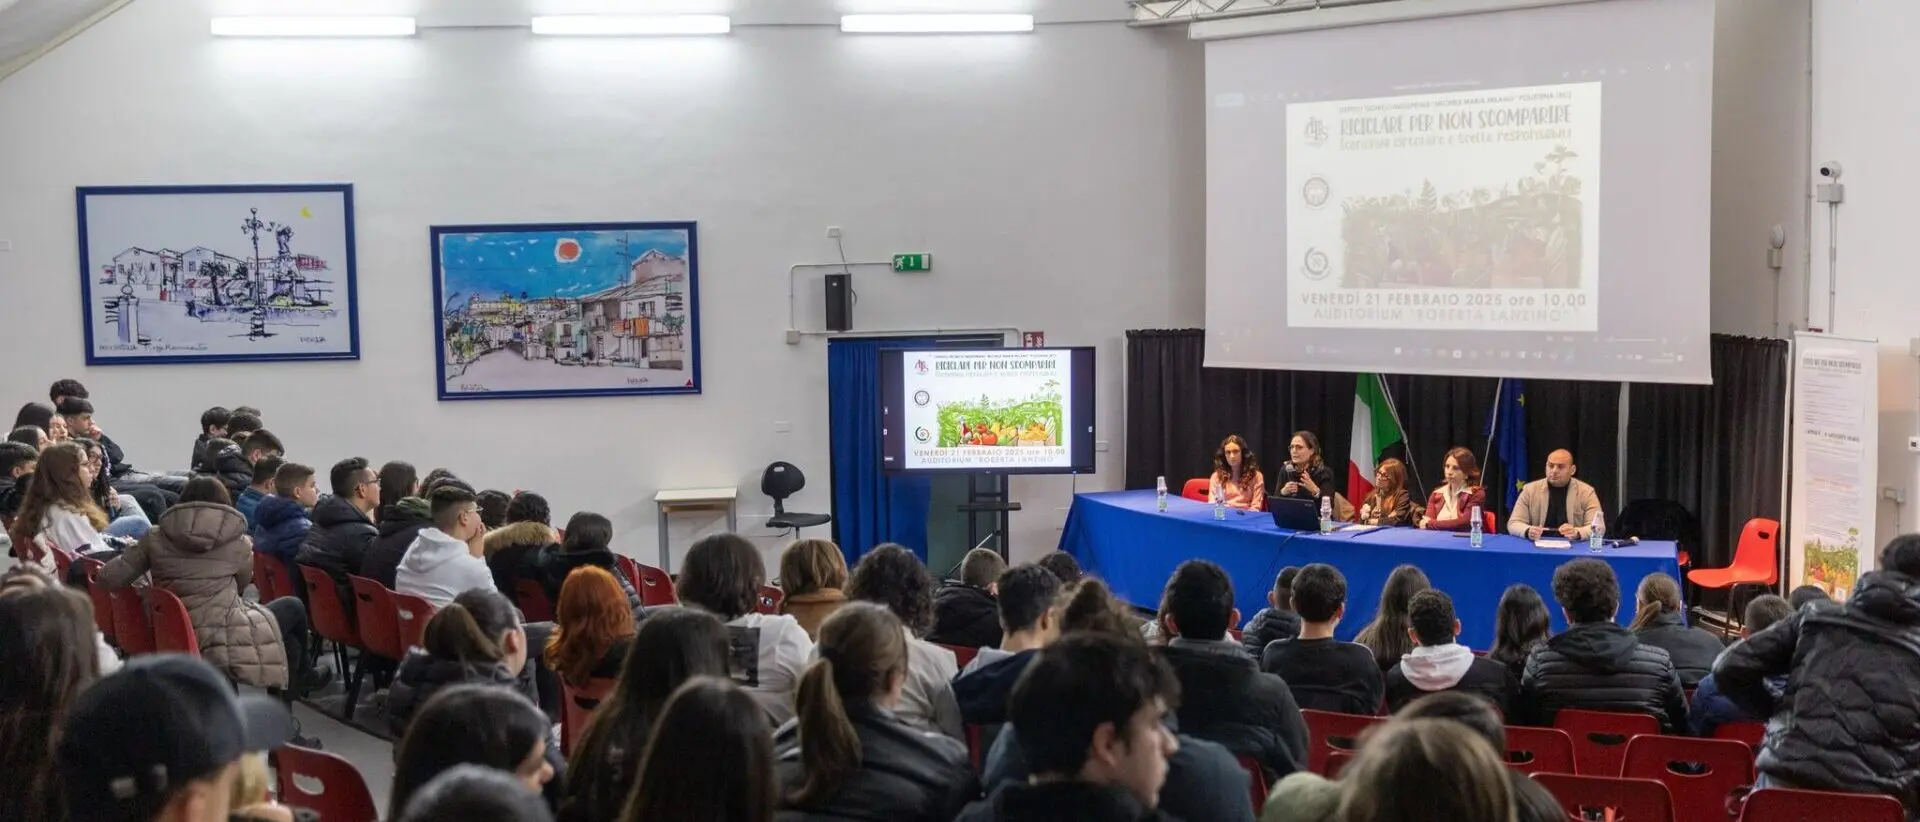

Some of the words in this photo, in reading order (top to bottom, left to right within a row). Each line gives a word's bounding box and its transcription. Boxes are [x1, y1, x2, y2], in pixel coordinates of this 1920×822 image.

[1340, 115, 1403, 136] RICICLARE
[1409, 113, 1434, 132] PER
[1438, 109, 1473, 131] NON
[1478, 104, 1573, 129] SCOMPARIRE
[1365, 292, 1381, 306] 21
[1387, 292, 1460, 307] FEBBRAIO
[1465, 292, 1503, 307] 2025
[1508, 294, 1536, 307] ore
[1313, 307, 1403, 321] AUDITORIUM
[989, 359, 1008, 371] NON
